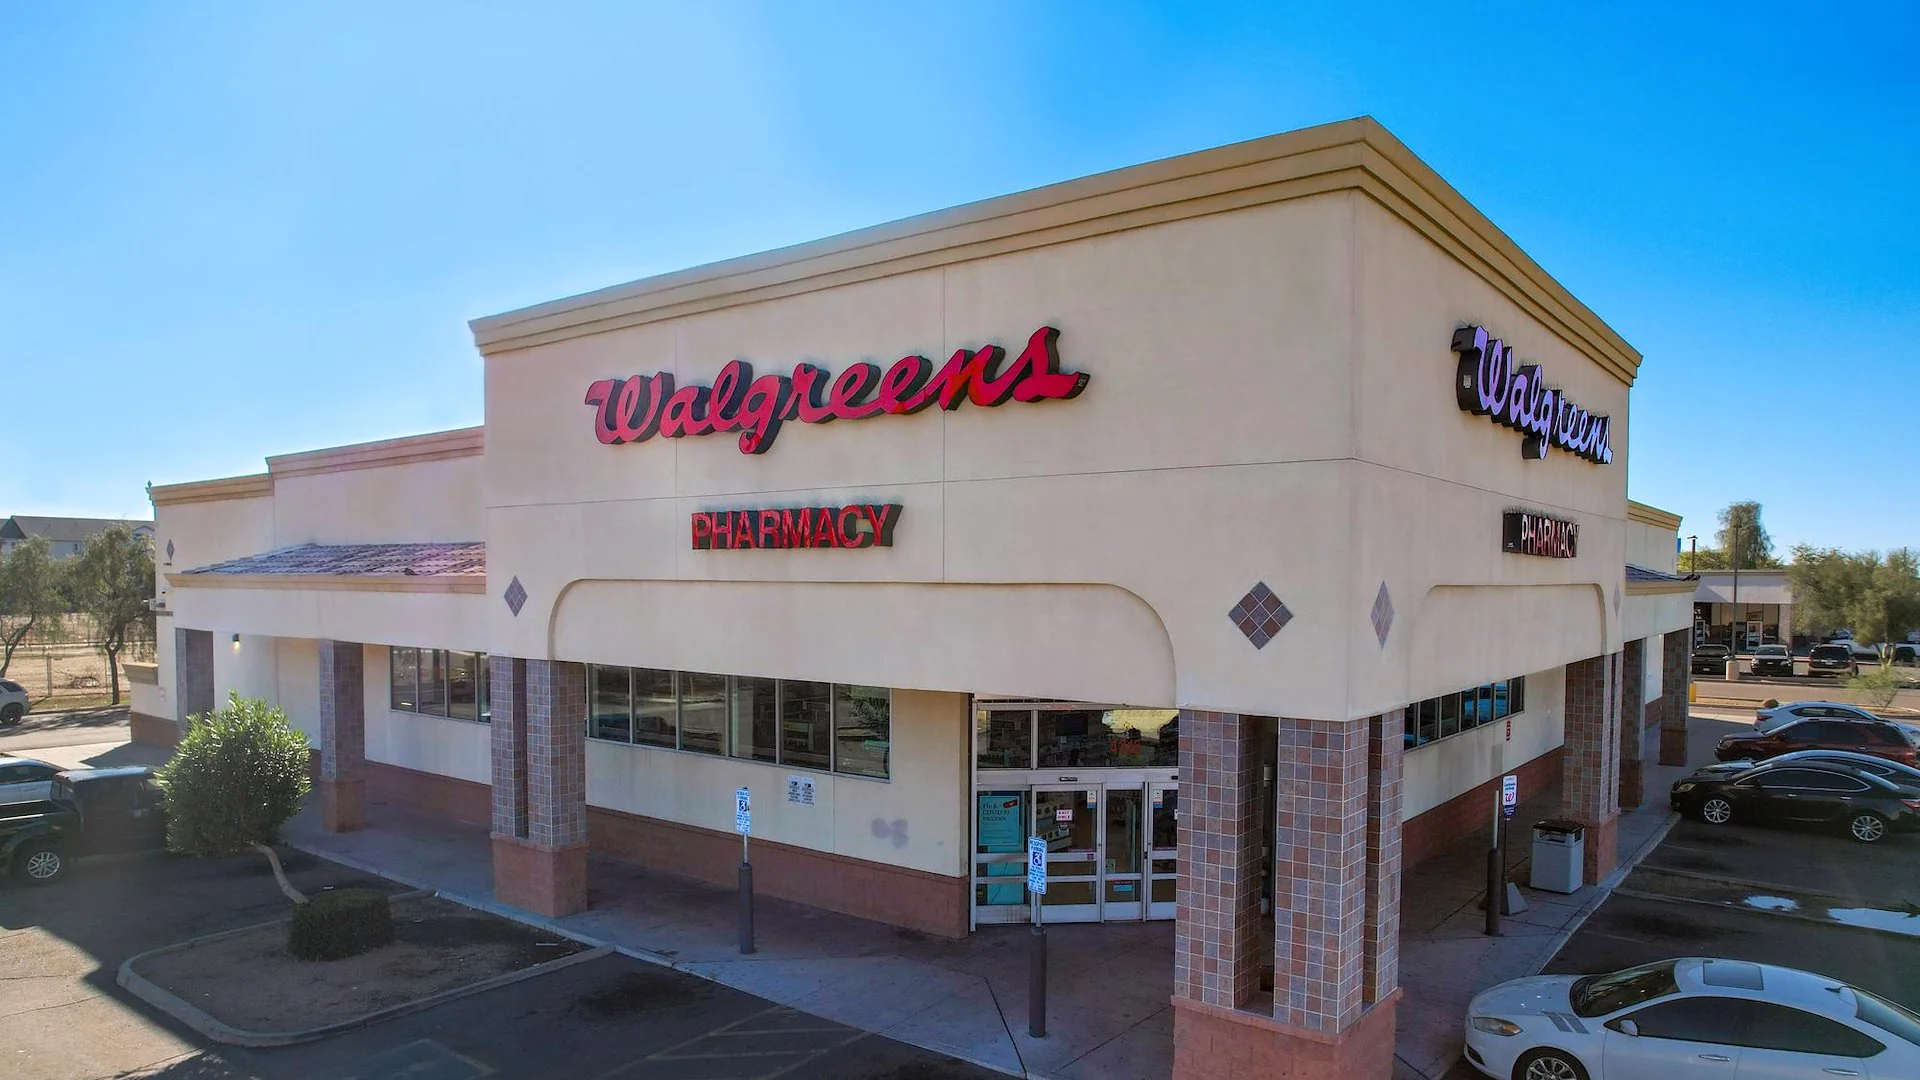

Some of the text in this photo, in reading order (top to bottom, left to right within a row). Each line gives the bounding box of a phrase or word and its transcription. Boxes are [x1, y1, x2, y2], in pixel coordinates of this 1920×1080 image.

[584, 326, 1088, 455] Walgreens
[1470, 325, 1613, 464] Walgreens
[692, 504, 901, 549] PHARMACY
[1520, 513, 1580, 558] PHARMACY
